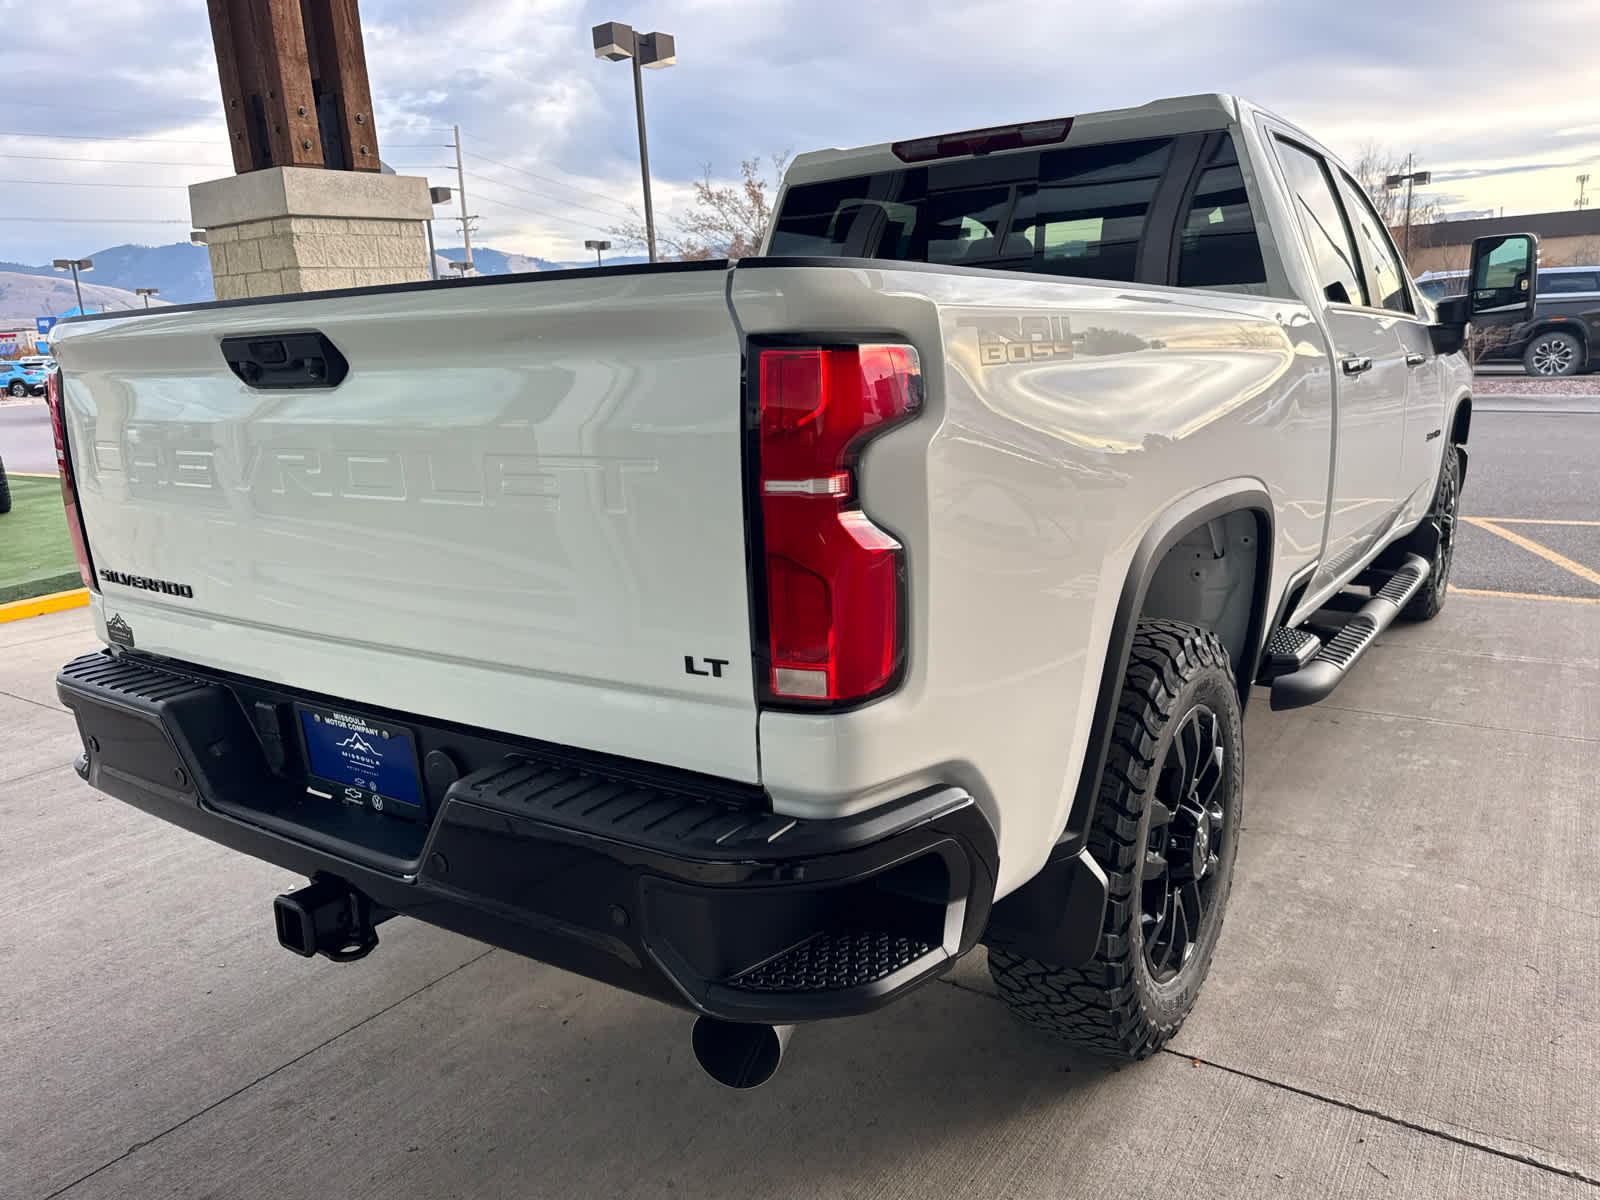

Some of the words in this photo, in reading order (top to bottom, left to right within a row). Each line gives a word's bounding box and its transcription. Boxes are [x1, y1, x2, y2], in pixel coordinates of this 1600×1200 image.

[91, 440, 659, 514] CHEVROLET
[100, 568, 193, 598] SILVERADO
[684, 655, 730, 678] LT
[325, 717, 347, 728] MOTOR
[348, 723, 378, 736] COMPANY
[333, 713, 366, 726] MISSOULA
[342, 751, 380, 766] MISSOULA
